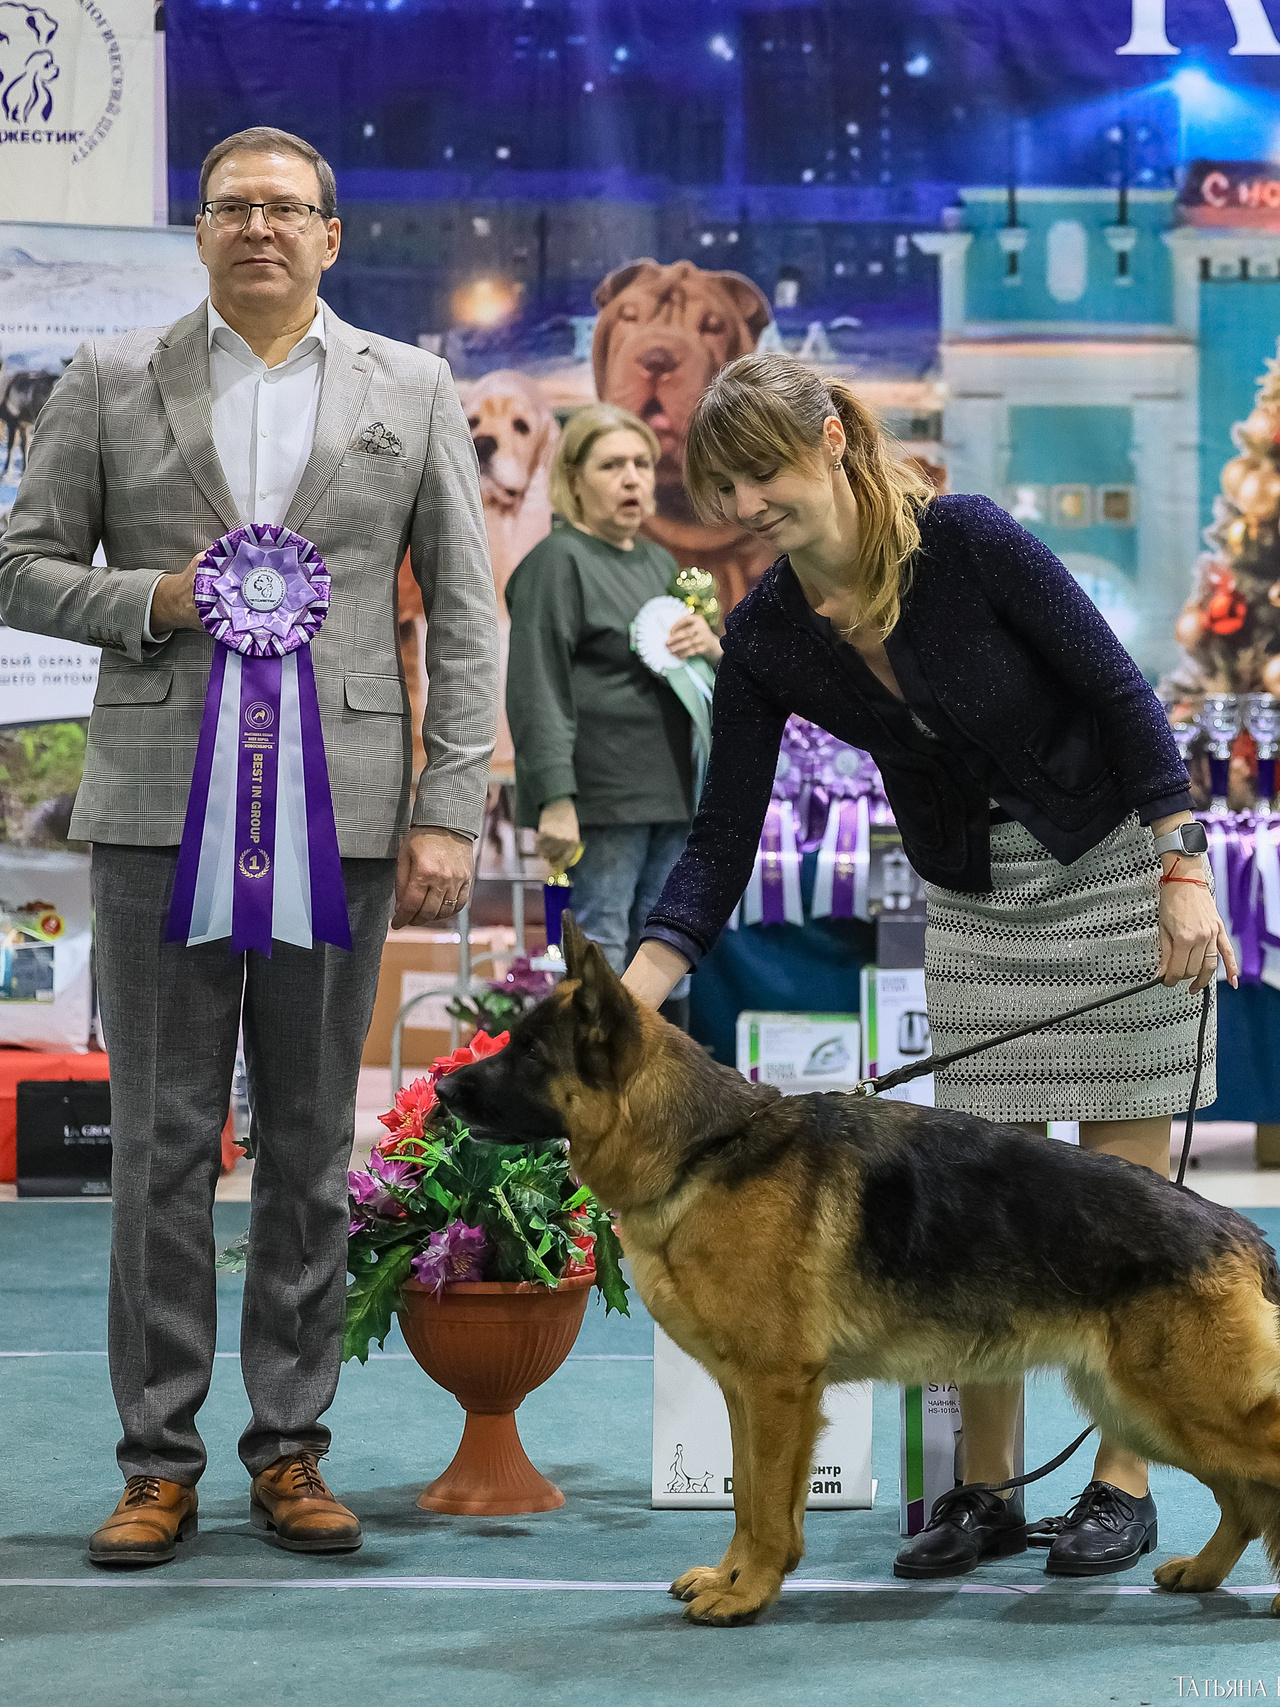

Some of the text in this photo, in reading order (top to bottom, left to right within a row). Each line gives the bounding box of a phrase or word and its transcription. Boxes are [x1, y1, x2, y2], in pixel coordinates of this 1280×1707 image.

[250, 752, 264, 844] BEST IN GROUP
[248, 855, 260, 870] 1
